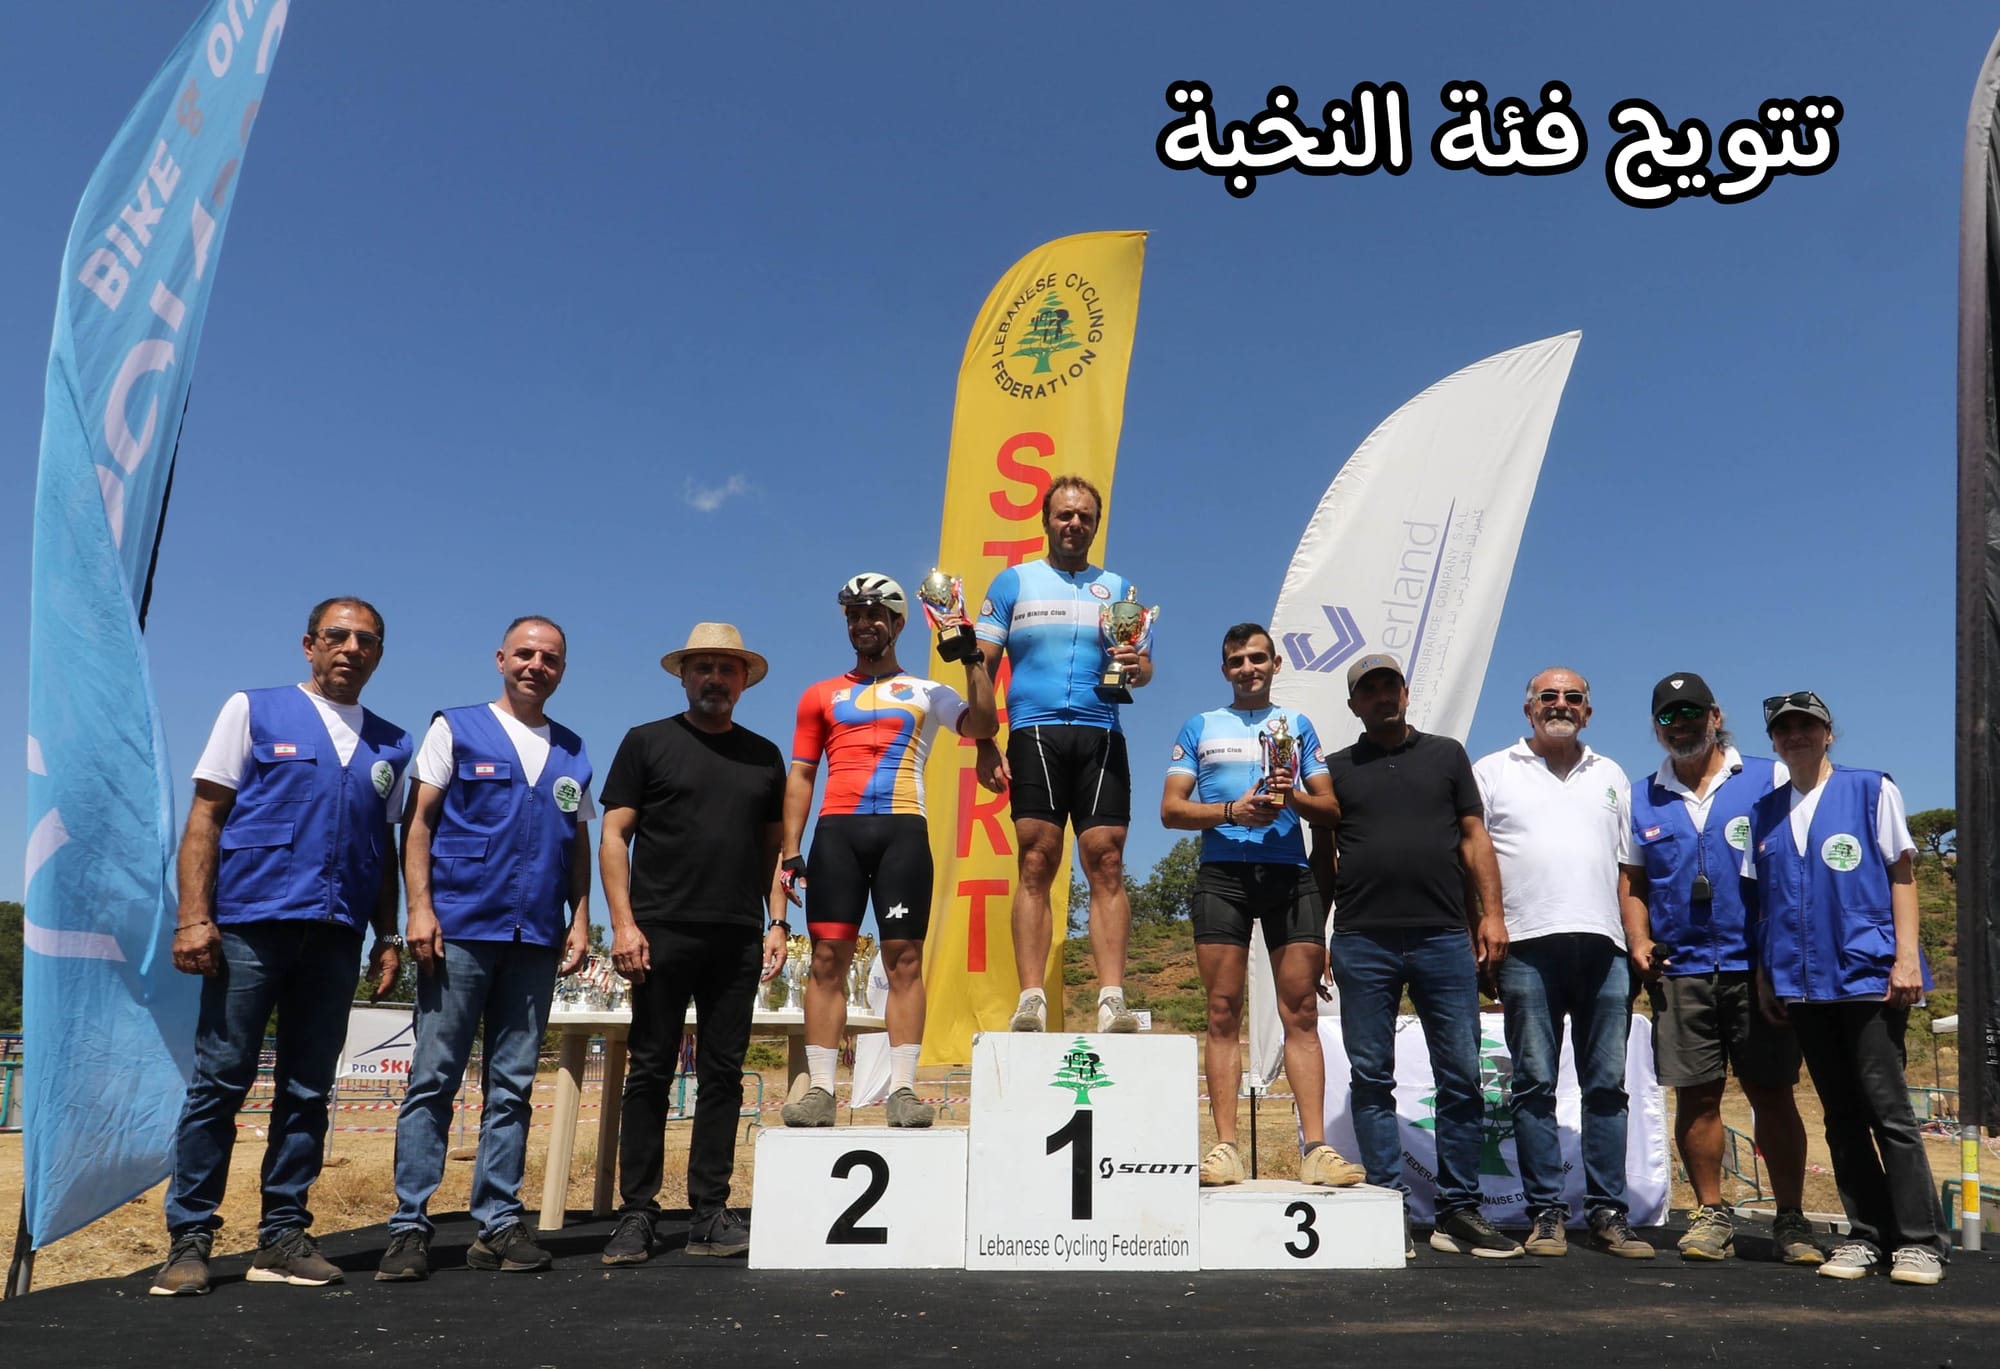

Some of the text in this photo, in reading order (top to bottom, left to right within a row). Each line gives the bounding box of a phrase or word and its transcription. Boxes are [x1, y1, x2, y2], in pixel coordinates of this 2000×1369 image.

[78, 138, 181, 313] BIKE
[992, 272, 1105, 358] LEBANESE CYCLING
[991, 348, 1097, 401] FEDERATION
[1380, 520, 1440, 667] erland
[1411, 614, 1443, 702] REINSURANCE
[1434, 547, 1459, 609] COMPANY
[351, 1063, 377, 1074] PRO
[825, 1149, 890, 1245] 2
[1046, 1109, 1093, 1221] 1
[1117, 1163, 1198, 1174] SCOTT
[1401, 1151, 1438, 1184] FEDERA
[979, 1233, 1189, 1263] Lebanese Cycling Federation
[1284, 1201, 1320, 1259] 3
